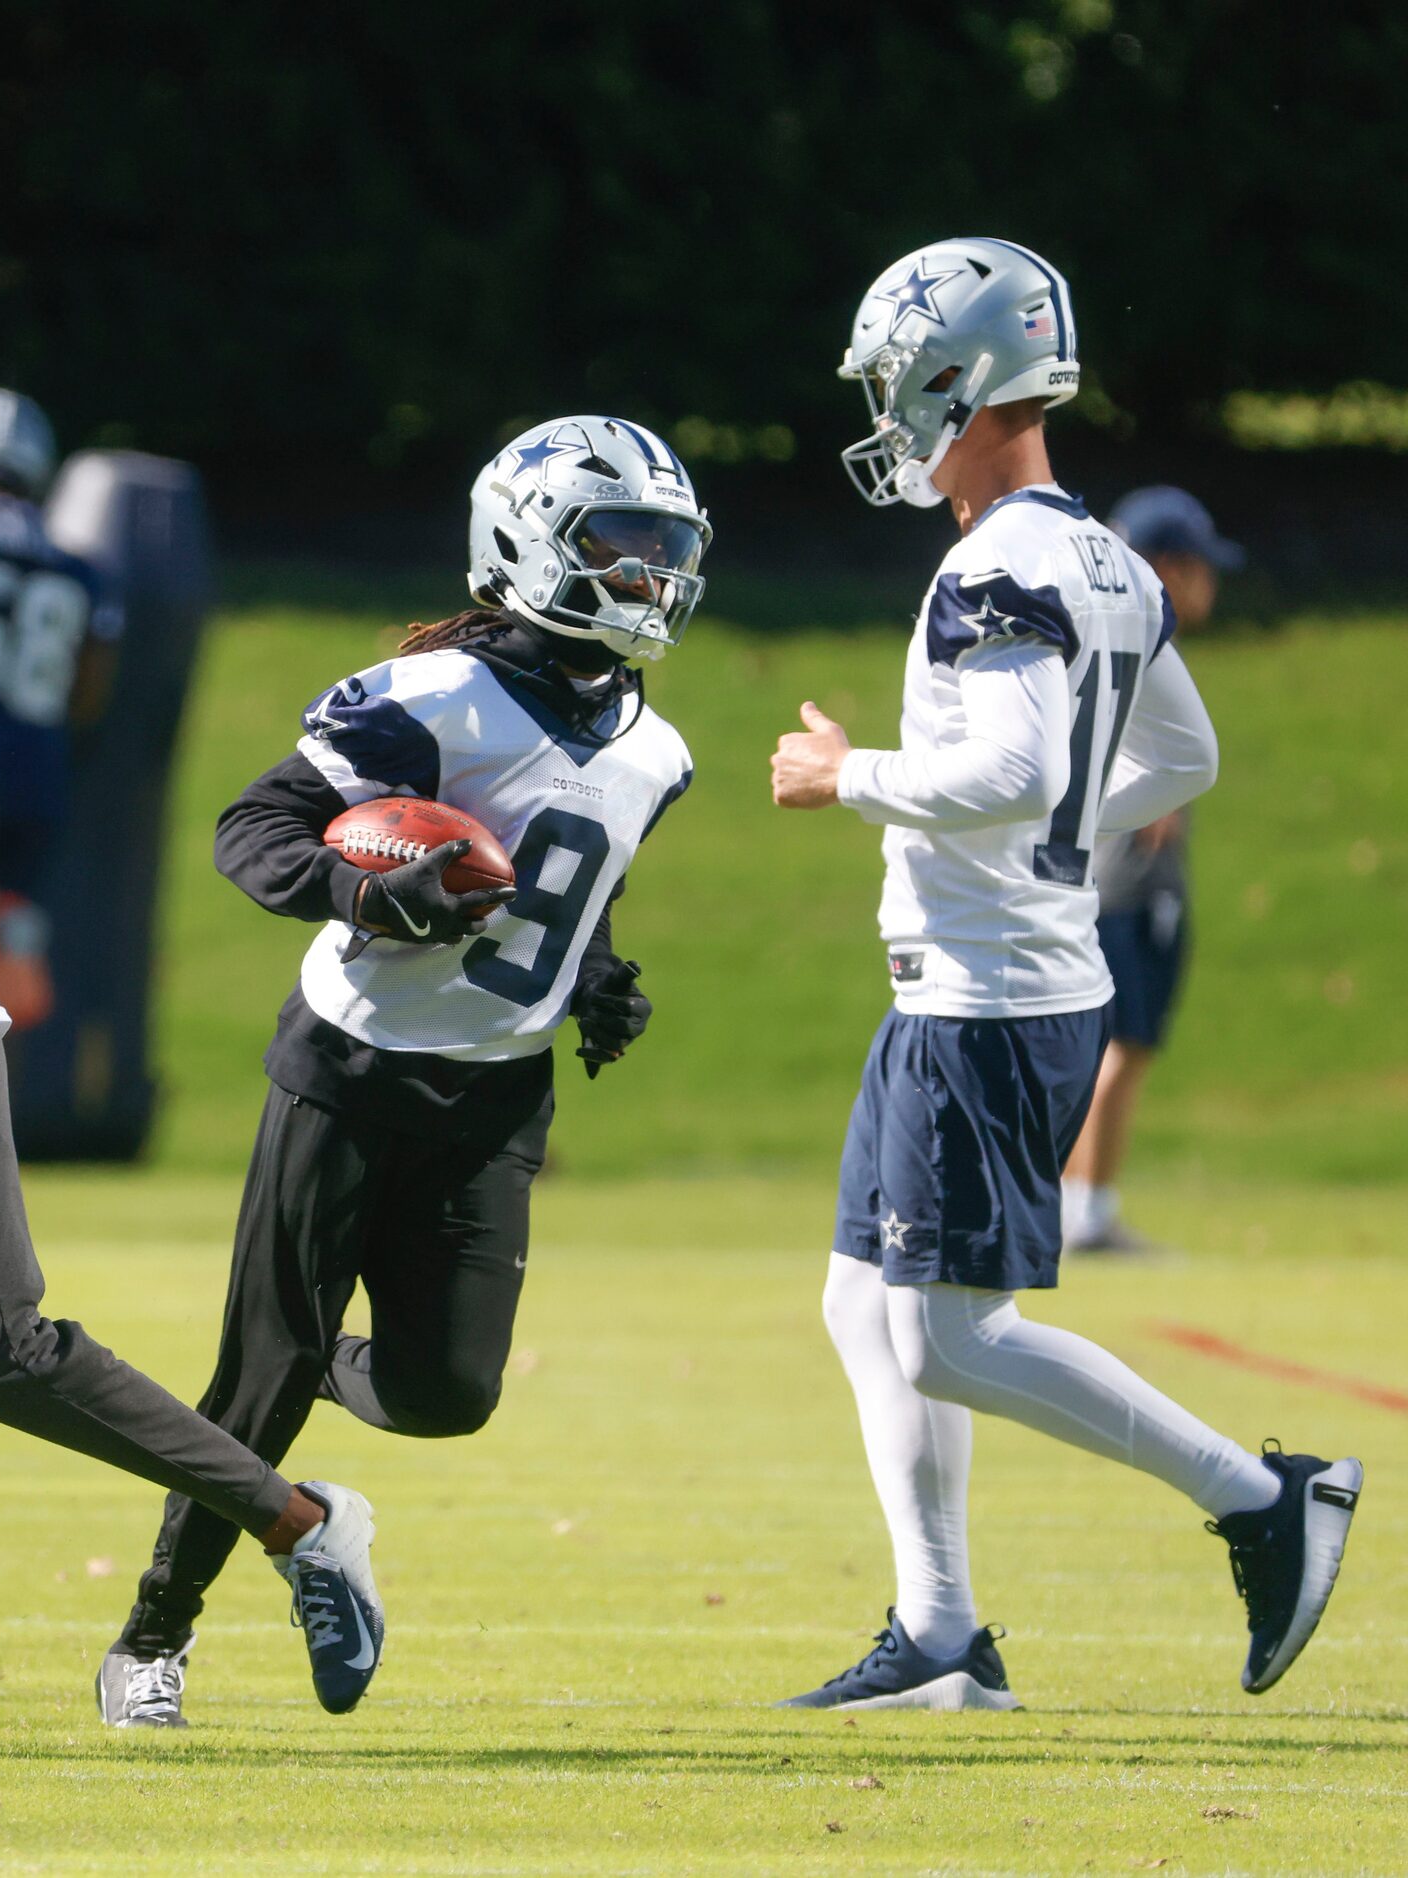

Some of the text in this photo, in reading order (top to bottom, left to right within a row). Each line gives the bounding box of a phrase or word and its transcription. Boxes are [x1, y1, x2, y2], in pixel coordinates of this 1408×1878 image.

[552, 778, 604, 800] COWBOYS
[1033, 650, 1141, 887] 17
[461, 807, 611, 1008] 9
